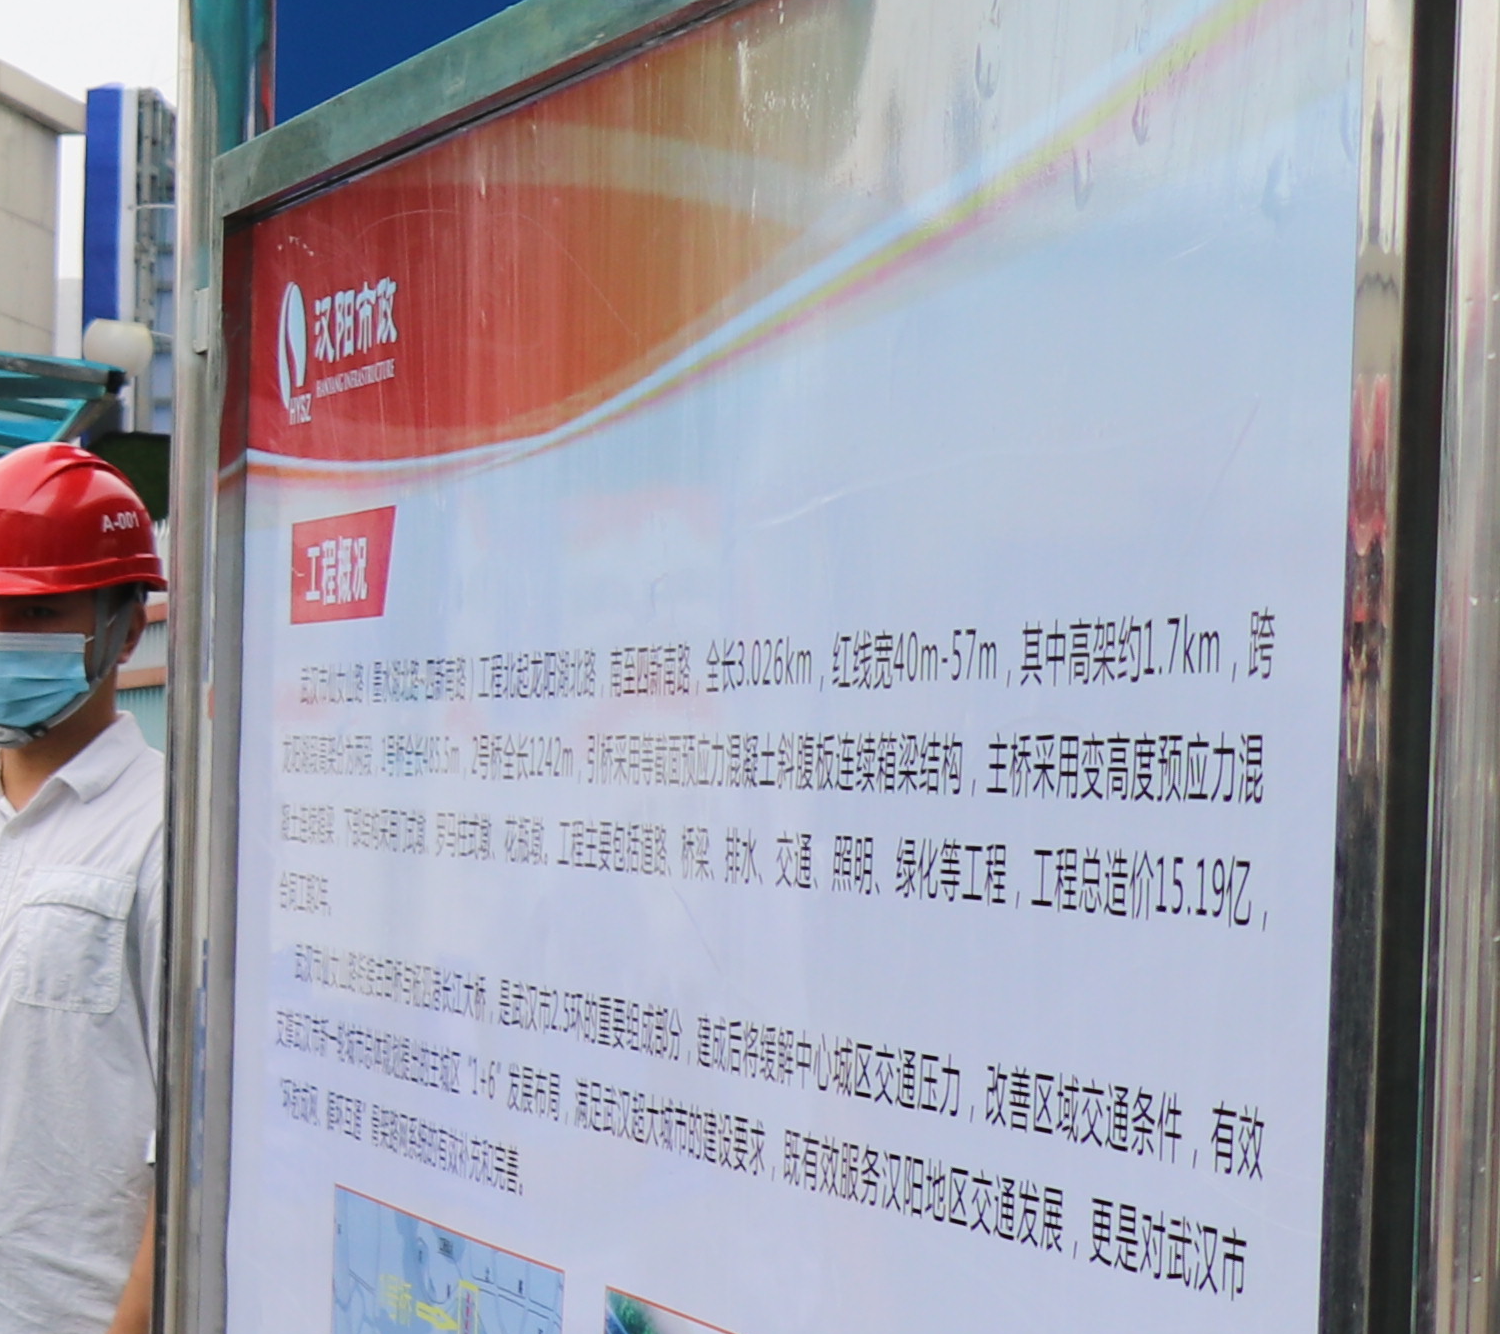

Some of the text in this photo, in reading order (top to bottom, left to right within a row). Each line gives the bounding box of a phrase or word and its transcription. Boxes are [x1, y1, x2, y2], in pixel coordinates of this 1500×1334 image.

[314, 276, 398, 363] 汉阳市政
[102, 511, 140, 533] A-001
[305, 535, 369, 606] 工程概况
